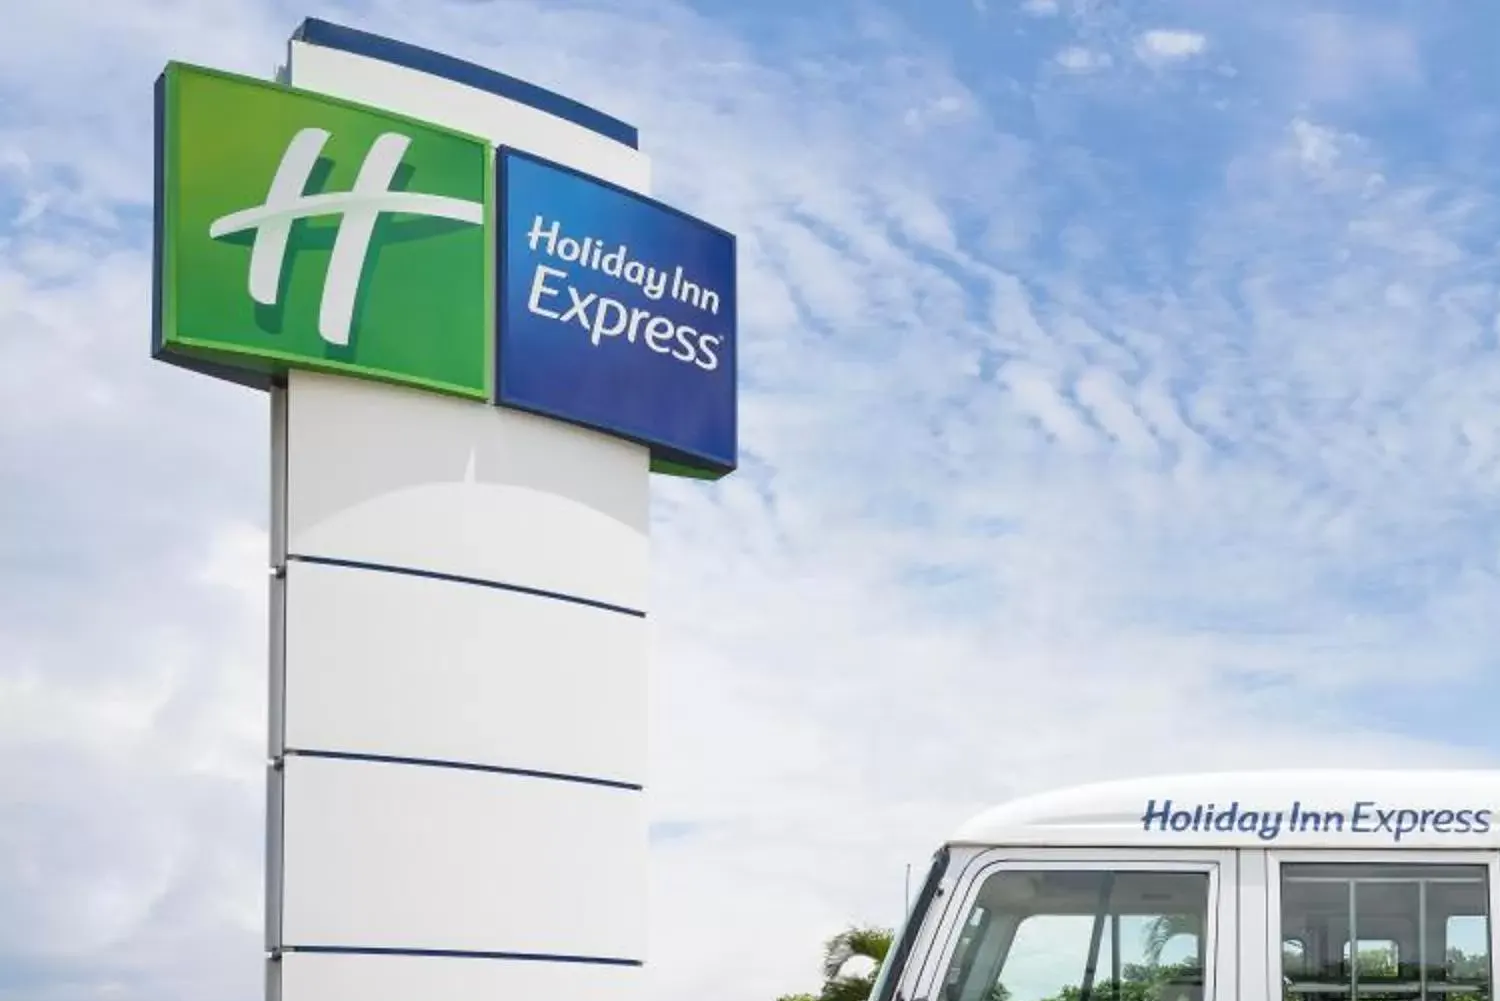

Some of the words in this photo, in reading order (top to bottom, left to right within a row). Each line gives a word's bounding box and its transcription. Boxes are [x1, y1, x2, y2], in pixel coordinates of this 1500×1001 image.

[527, 215, 667, 299] Holiday
[671, 266, 720, 315] Inn
[527, 264, 720, 370] Express
[1140, 800, 1283, 840] Holiday
[1289, 801, 1345, 832] Inn
[1351, 801, 1492, 842] Express
